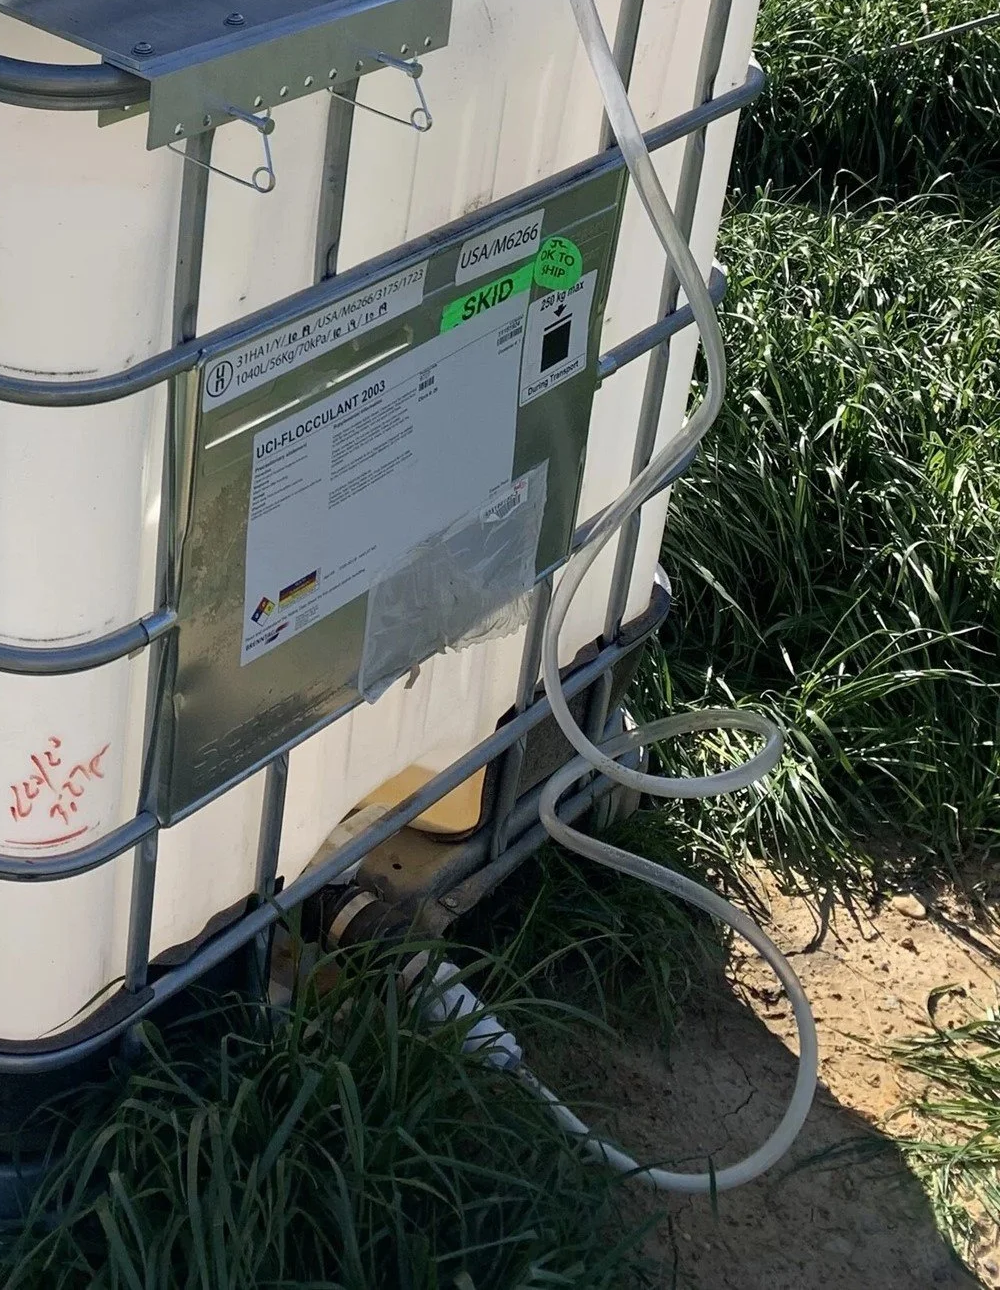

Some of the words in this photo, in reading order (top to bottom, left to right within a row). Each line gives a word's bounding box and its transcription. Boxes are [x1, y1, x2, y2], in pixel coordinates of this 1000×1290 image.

[460, 223, 539, 269] USA/M6266
[541, 249, 555, 261] OK
[559, 250, 575, 267] TO
[541, 265, 566, 278] SHIP
[461, 278, 514, 321] SKID
[540, 294, 555, 311] 250
[556, 290, 566, 303] kg
[567, 280, 585, 296] max
[527, 375, 549, 396] During
[549, 360, 580, 383] Transport
[256, 395, 360, 459] UCI-FLOCCULANT
[361, 380, 386, 403] 2003
